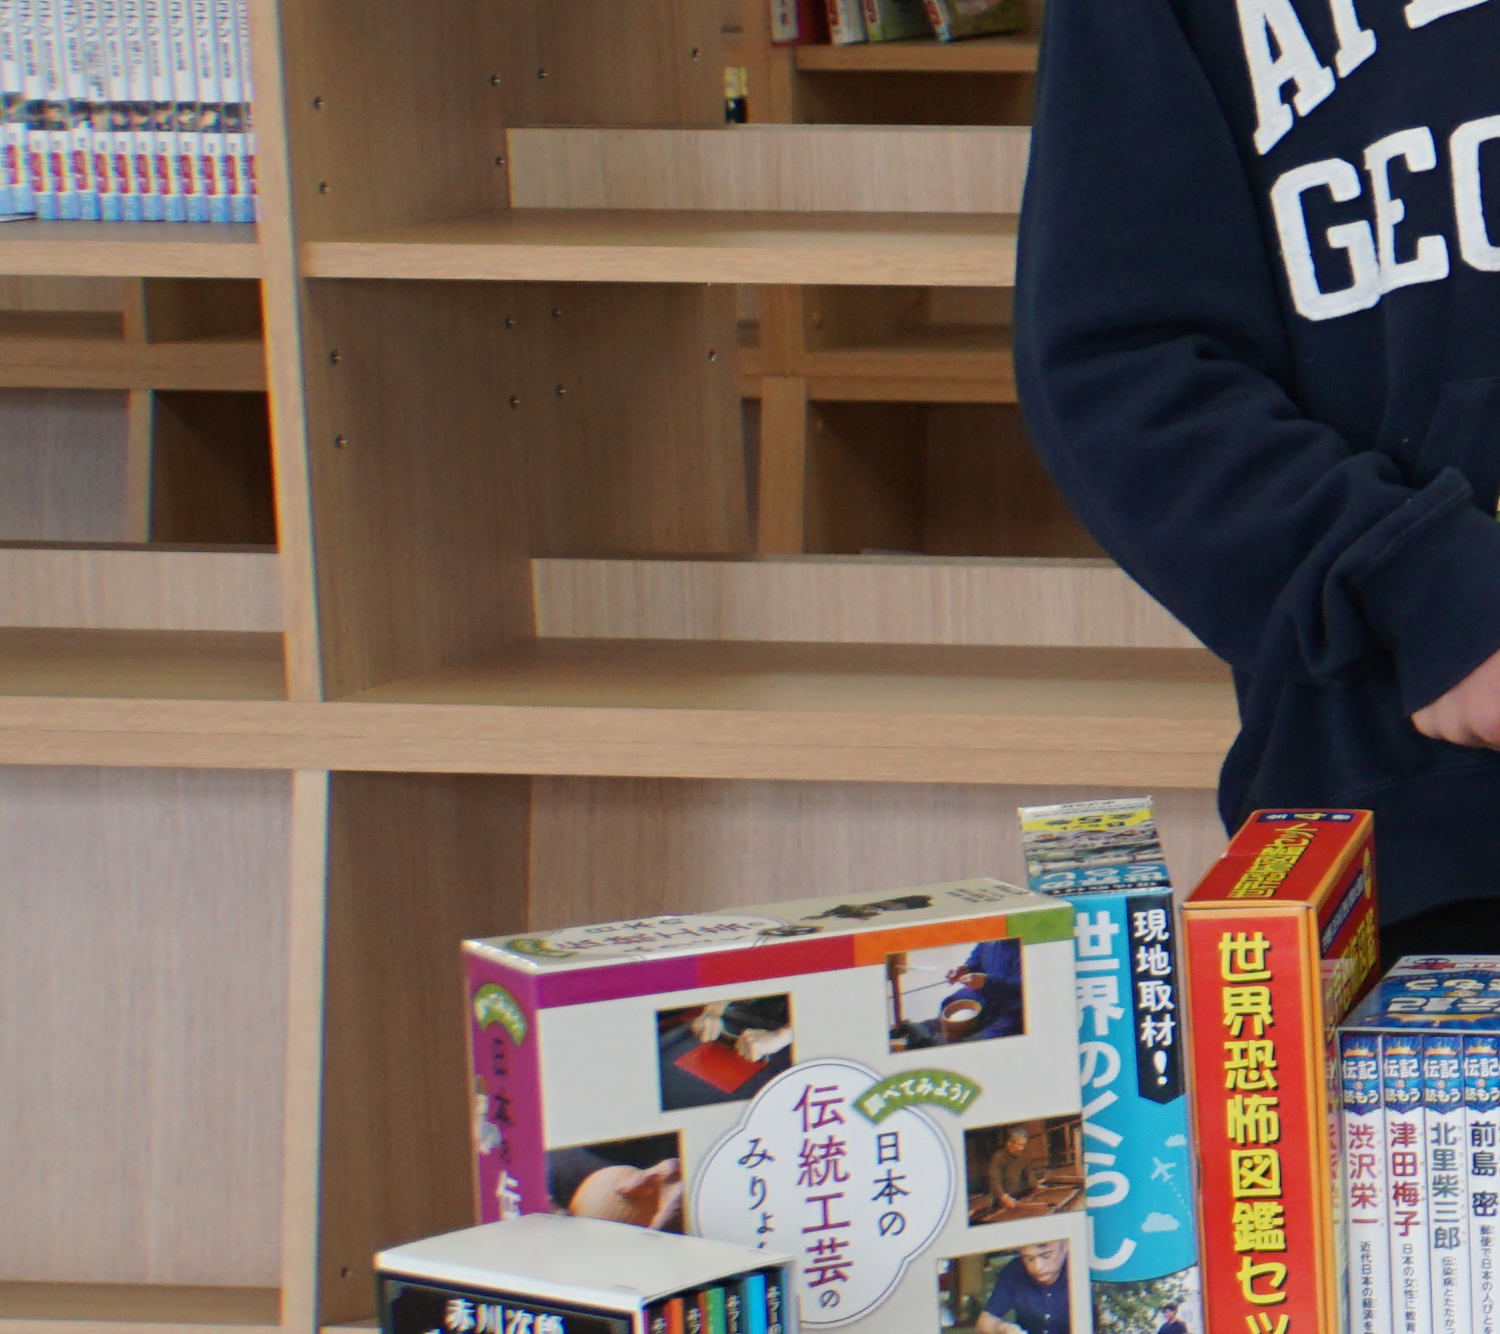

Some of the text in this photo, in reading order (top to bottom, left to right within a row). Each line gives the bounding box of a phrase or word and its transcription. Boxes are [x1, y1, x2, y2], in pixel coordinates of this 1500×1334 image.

[1133, 907, 1178, 1087] 現地取材!
[791, 1083, 853, 1310] 伝統工芸の
[871, 1131, 911, 1238] 日本の
[1349, 1123, 1380, 1226] 渋沢栄一
[1390, 1121, 1422, 1238] 津田梅子
[1431, 1121, 1461, 1251] 北里柴三郎
[1470, 1121, 1500, 1178] 前島
